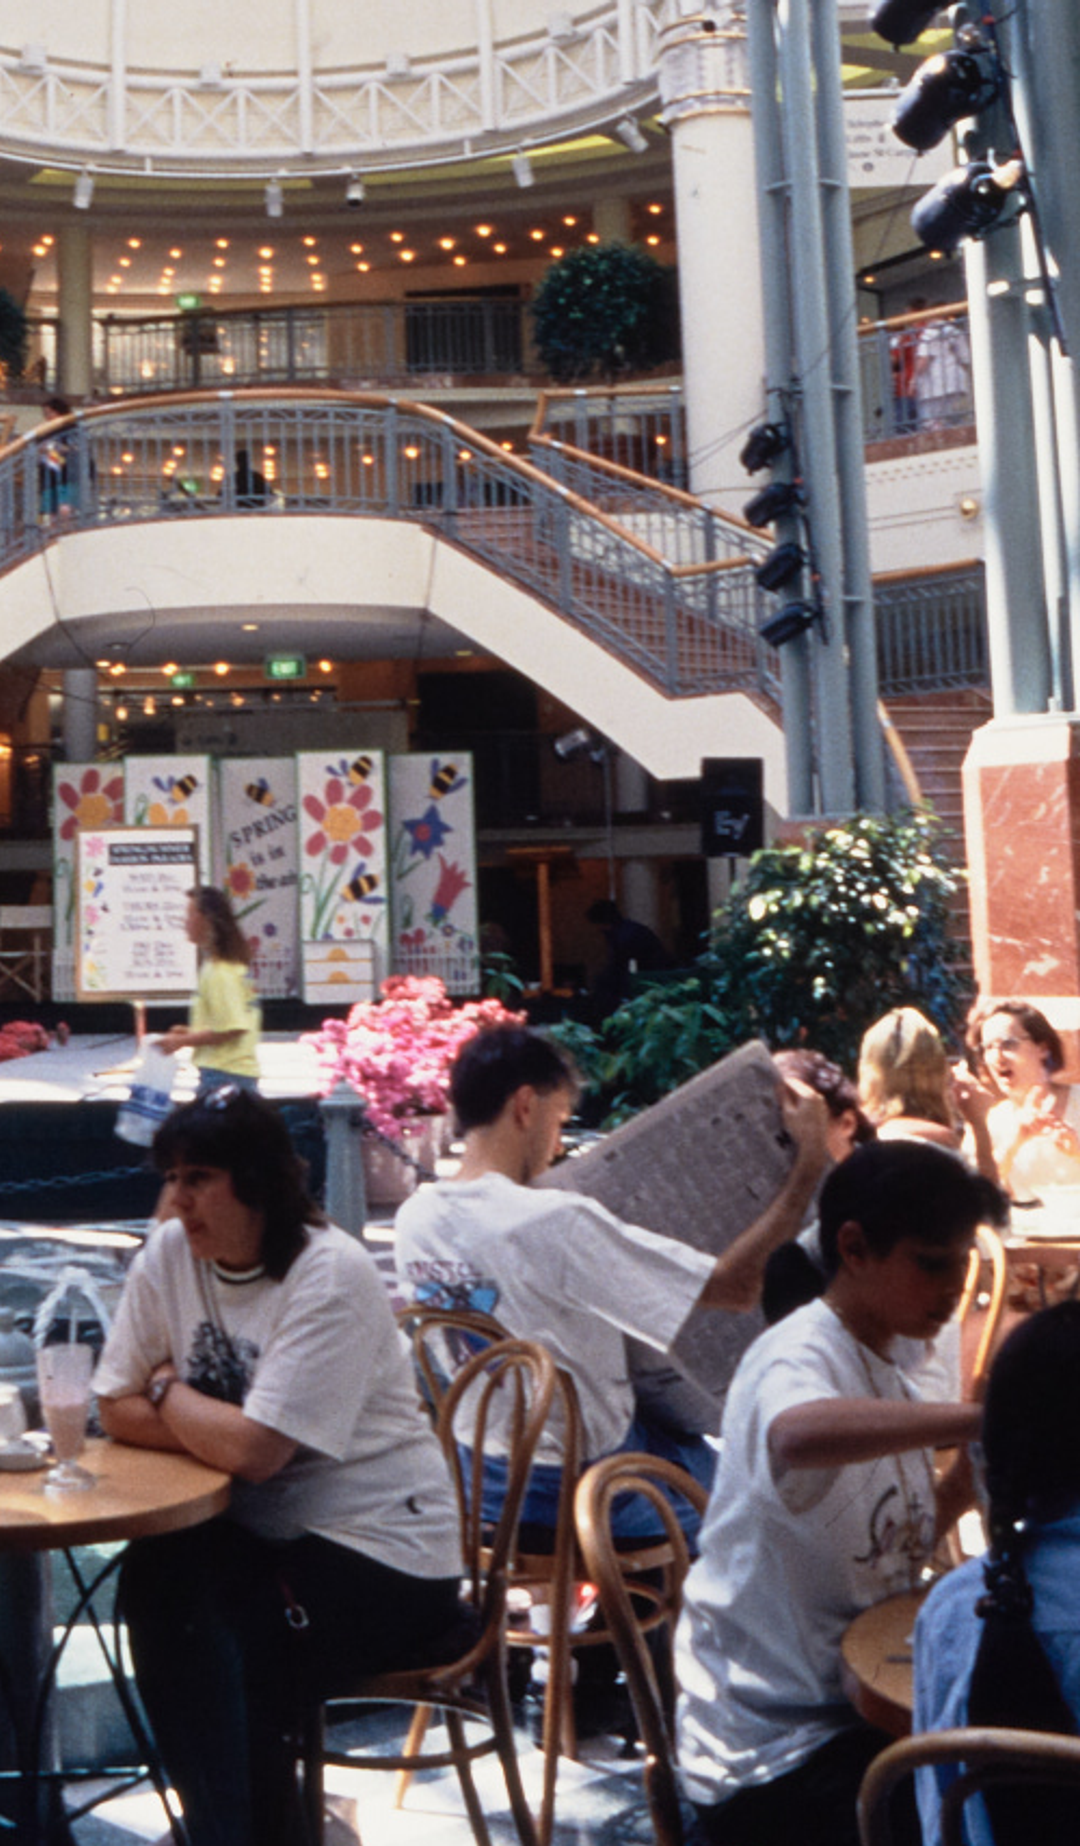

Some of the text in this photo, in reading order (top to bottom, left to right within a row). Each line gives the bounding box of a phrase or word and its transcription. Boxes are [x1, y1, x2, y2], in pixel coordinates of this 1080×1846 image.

[229, 804, 297, 848] SPRING
[250, 845, 286, 867] is in
[256, 873, 277, 890] the
